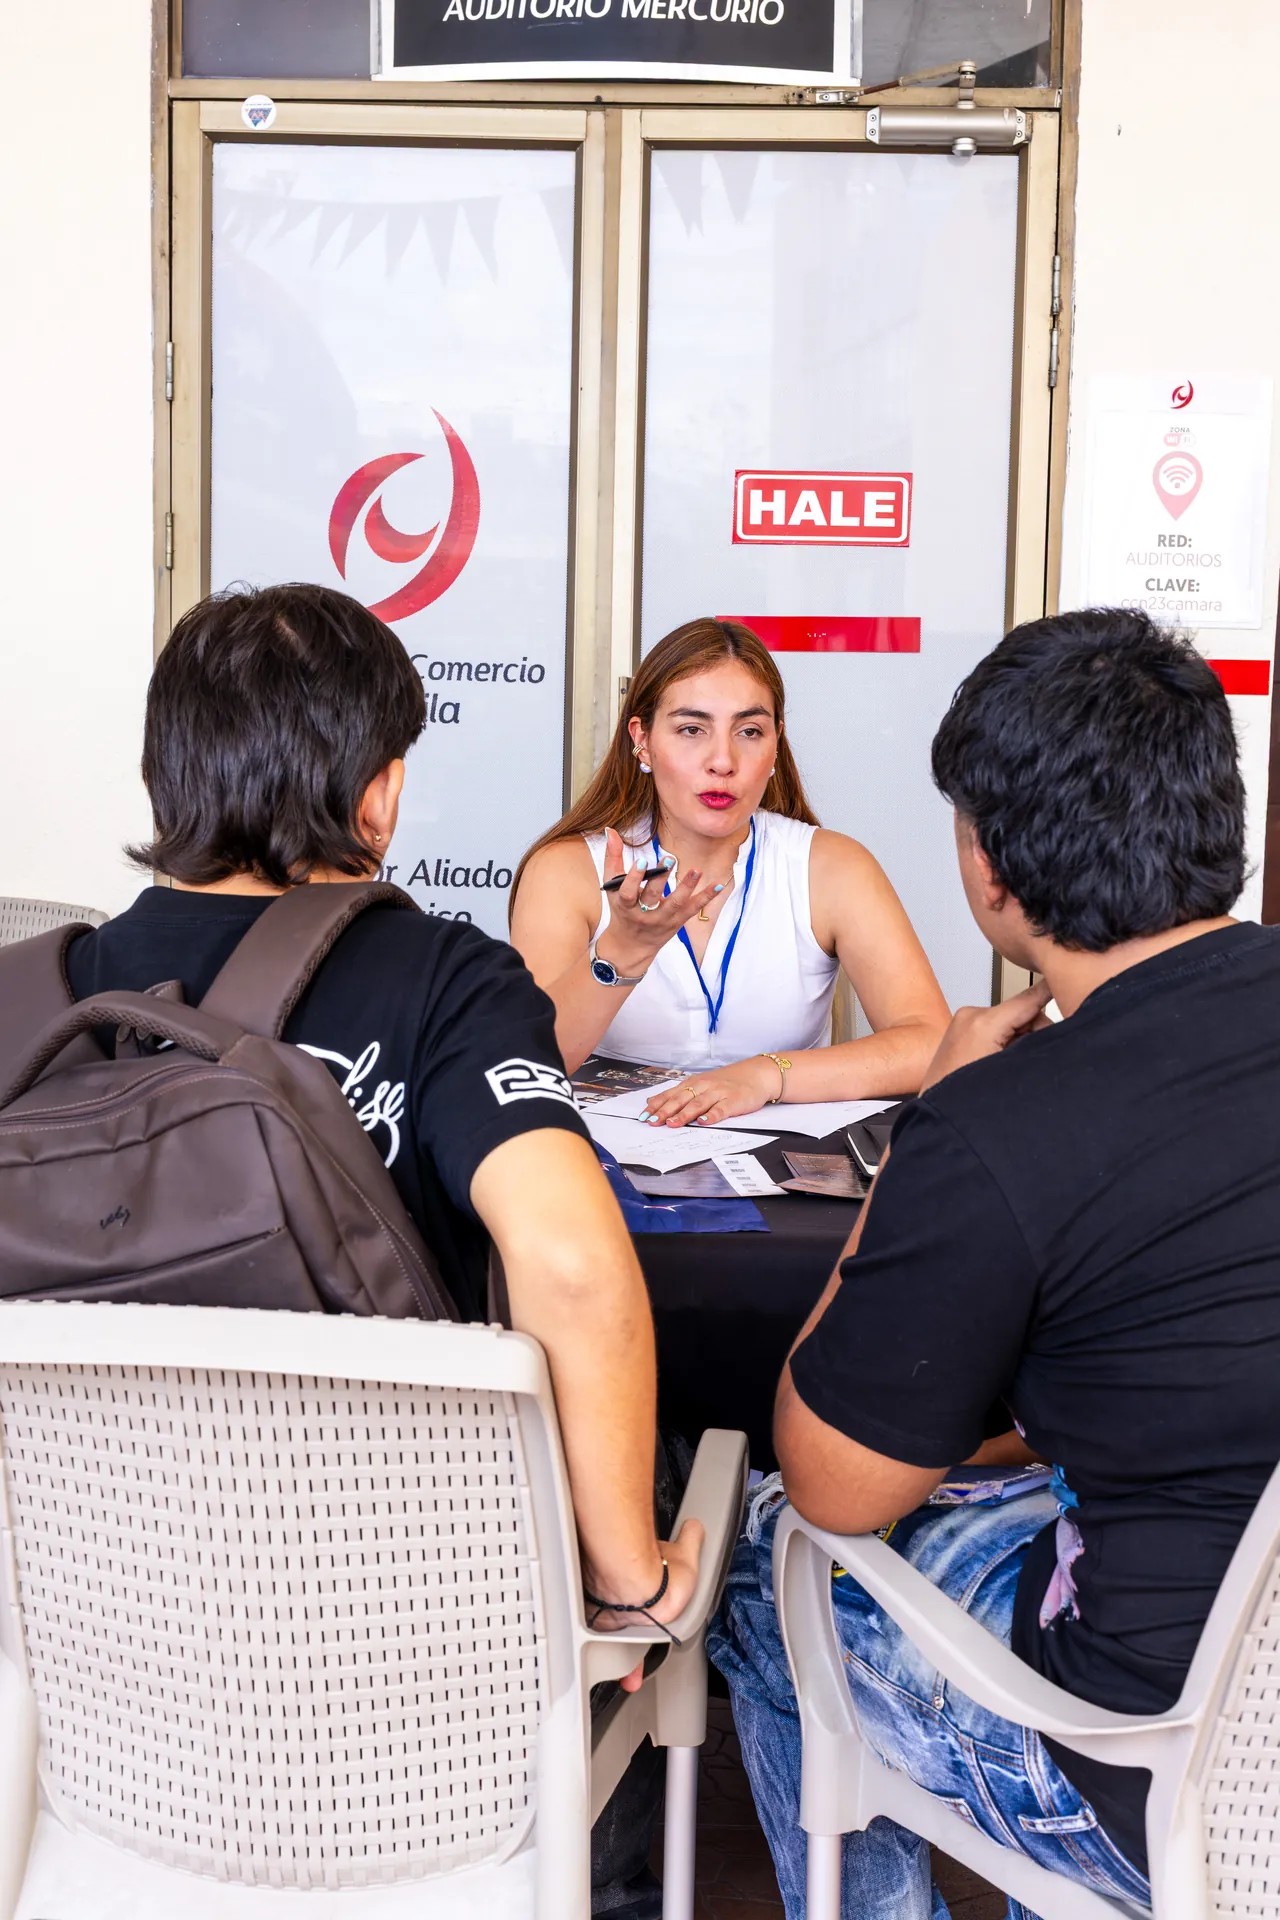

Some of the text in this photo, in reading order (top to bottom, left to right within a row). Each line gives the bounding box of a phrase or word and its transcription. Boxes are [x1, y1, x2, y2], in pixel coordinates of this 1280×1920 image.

[442, 0, 785, 25] AUDITORIO MERCURIO
[749, 489, 896, 528] HALE
[1157, 534, 1192, 548] RED:
[1125, 552, 1222, 568] AUDITORIOS
[1145, 578, 1200, 593] CLAVE:
[406, 858, 513, 889] Aliado
